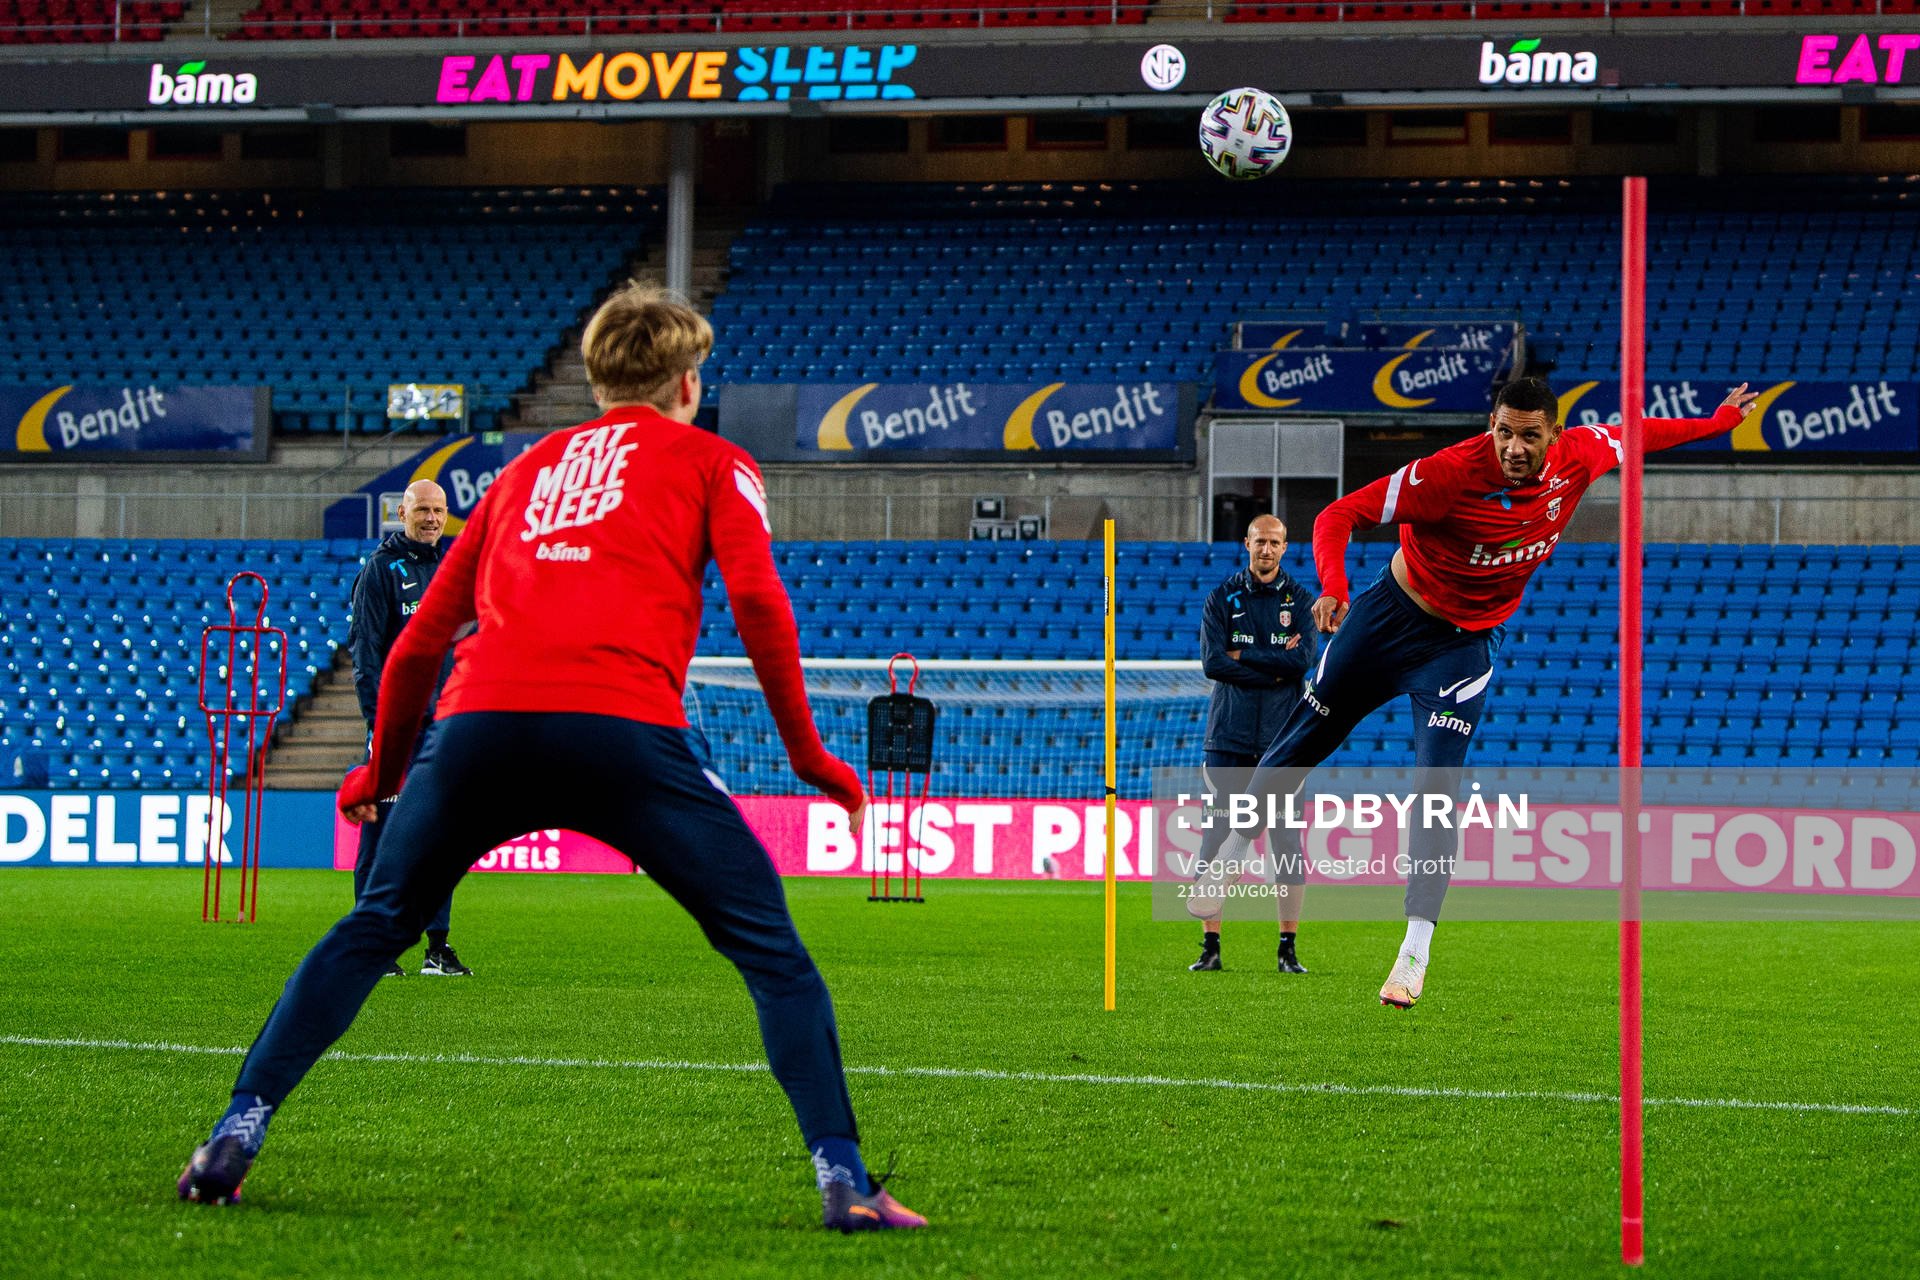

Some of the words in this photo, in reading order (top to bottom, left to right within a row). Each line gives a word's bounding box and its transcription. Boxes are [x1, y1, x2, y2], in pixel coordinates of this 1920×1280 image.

[436, 54, 550, 102] EAT
[552, 52, 728, 100] MOVE
[1795, 33, 1920, 84] EAT
[1264, 353, 1334, 394] Bendit
[1399, 353, 1469, 394] Bendit
[57, 385, 168, 449] Bendit
[561, 422, 638, 462] EAT
[860, 382, 977, 448] Bendit
[1047, 381, 1164, 448] Bendit
[1776, 381, 1900, 449] Bendit
[530, 442, 639, 503] MOVE
[520, 485, 624, 542] SLEEP
[1232, 633, 1254, 645] ama
[0, 794, 233, 863] DELER
[808, 803, 1012, 873] BEST
[1032, 804, 1204, 878] PRIS
[1397, 808, 1651, 886] LEST
[1671, 812, 1917, 889] FORD
[473, 845, 560, 870] OTELS
